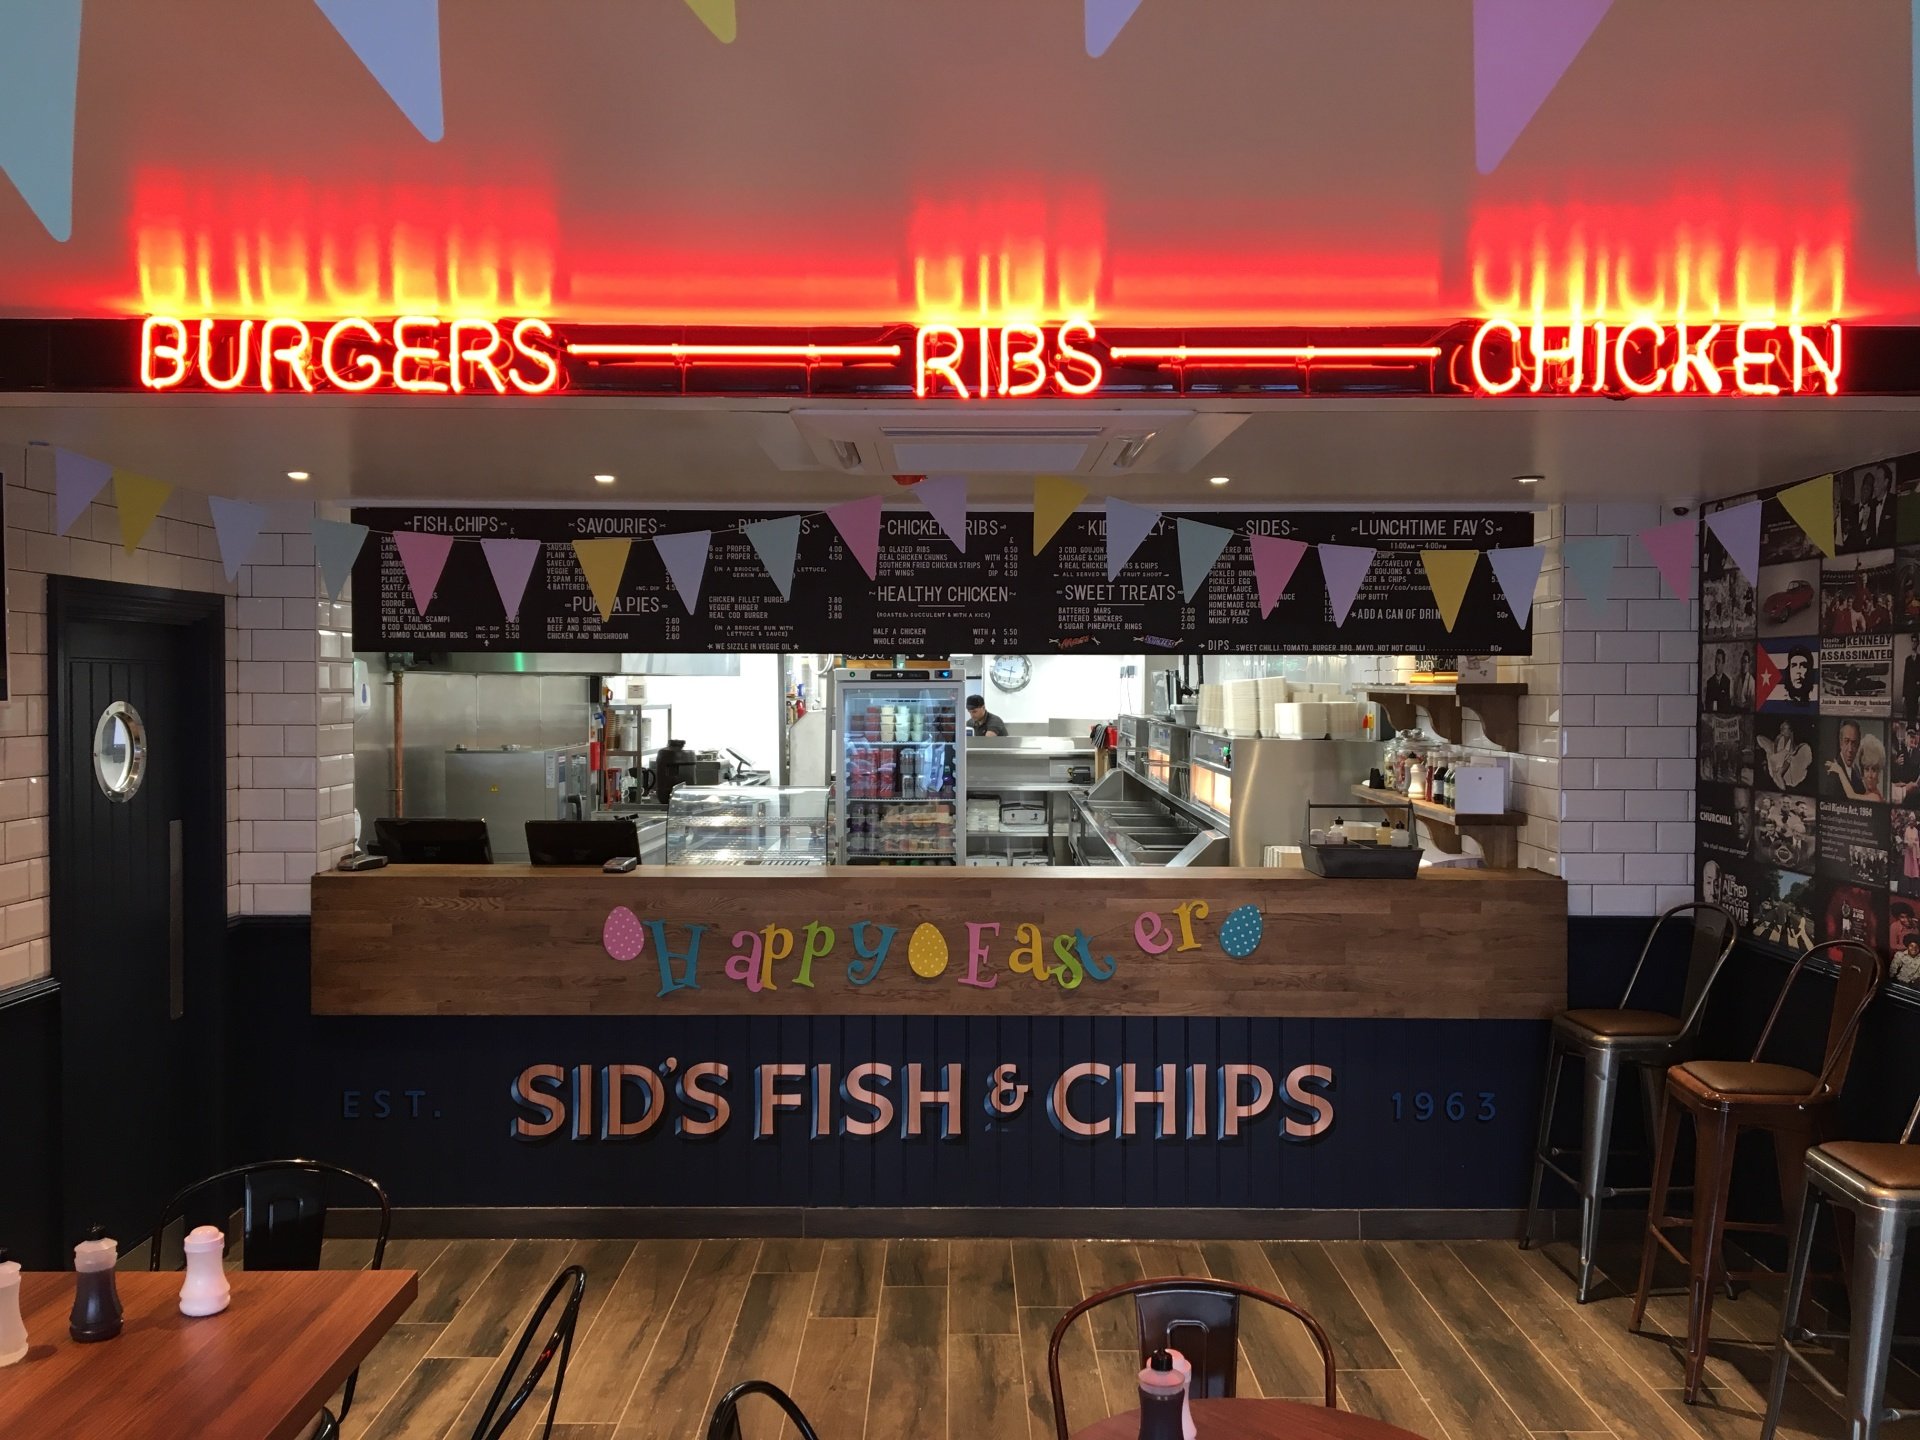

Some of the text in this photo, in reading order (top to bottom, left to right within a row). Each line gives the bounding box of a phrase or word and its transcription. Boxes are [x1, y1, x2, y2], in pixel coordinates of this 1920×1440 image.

[140, 315, 558, 392] BURGERS
[916, 318, 1102, 397] RIBS
[1471, 319, 1842, 394] CHICKEN
[413, 516, 498, 532] FISH CHIPS
[577, 518, 657, 534] SAVOURIES
[1246, 520, 1290, 535] SIDES
[1359, 520, 1446, 535] LUNCHTIME
[877, 586, 1008, 602] HEALTHY CHICKEN
[1065, 585, 1176, 600] SWEET TREATS
[627, 597, 659, 612] PIES
[1358, 609, 1417, 619] ADD A CAN OF
[1208, 640, 1229, 651] DIPS
[1847, 635, 1891, 645] KENNEDY
[1821, 650, 1893, 660] ASSASSINATED
[1700, 812, 1732, 825] CHURCHILL
[1723, 880, 1747, 897] ALFRED
[342, 1090, 441, 1119] EST.
[510, 1056, 731, 1141] SID'S
[754, 1063, 1334, 1141] FISH & CHIPS
[1392, 1092, 1497, 1121] 1963
